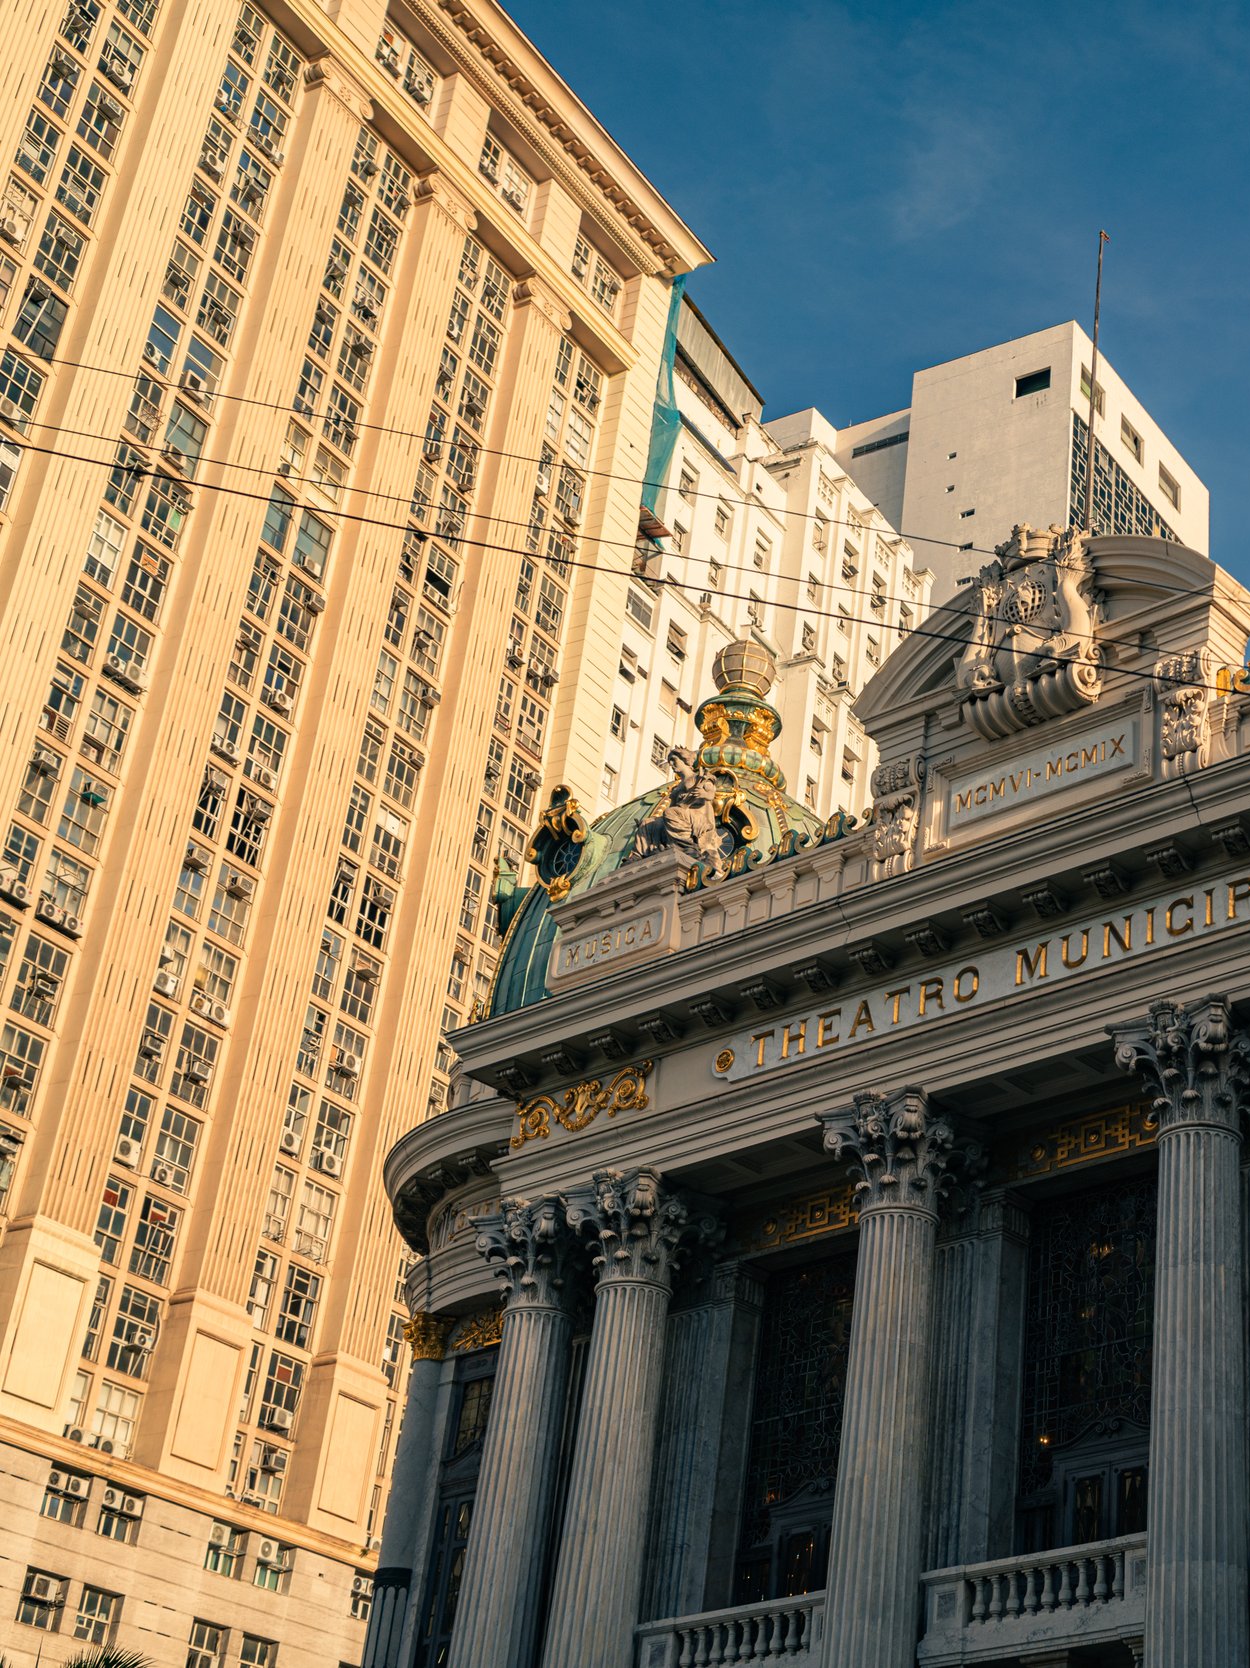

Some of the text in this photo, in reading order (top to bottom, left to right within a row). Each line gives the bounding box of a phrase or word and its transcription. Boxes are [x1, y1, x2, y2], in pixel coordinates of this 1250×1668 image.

[955, 734, 1126, 814] MCMVI-MCMIX
[565, 920, 653, 968] MUSICA
[749, 966, 981, 1068] THEATRO
